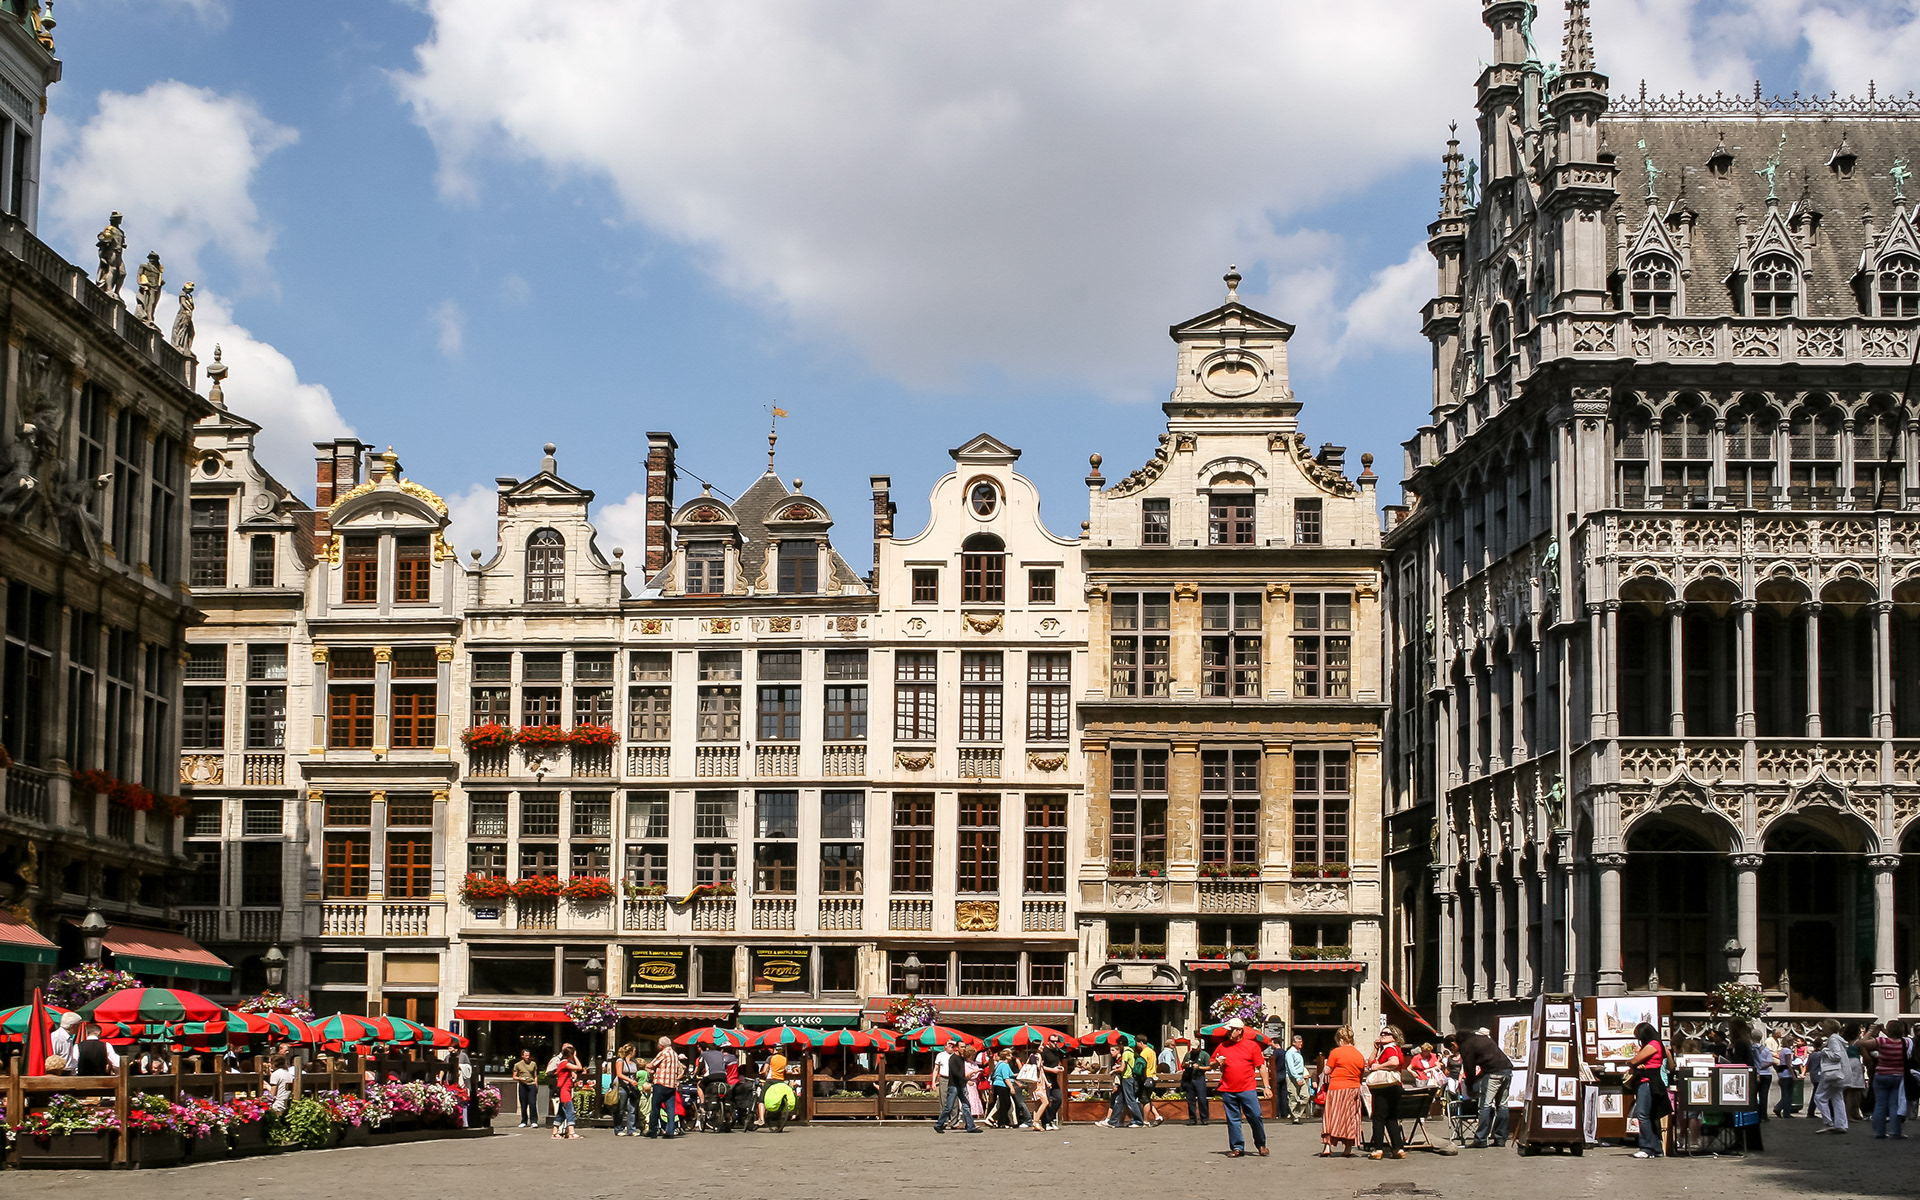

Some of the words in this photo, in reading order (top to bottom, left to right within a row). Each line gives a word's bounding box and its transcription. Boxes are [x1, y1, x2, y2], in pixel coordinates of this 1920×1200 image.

[638, 966, 676, 976] aroma
[762, 966, 801, 976] aroma
[774, 1016, 786, 1024] EL
[790, 1016, 823, 1024] GRECO
